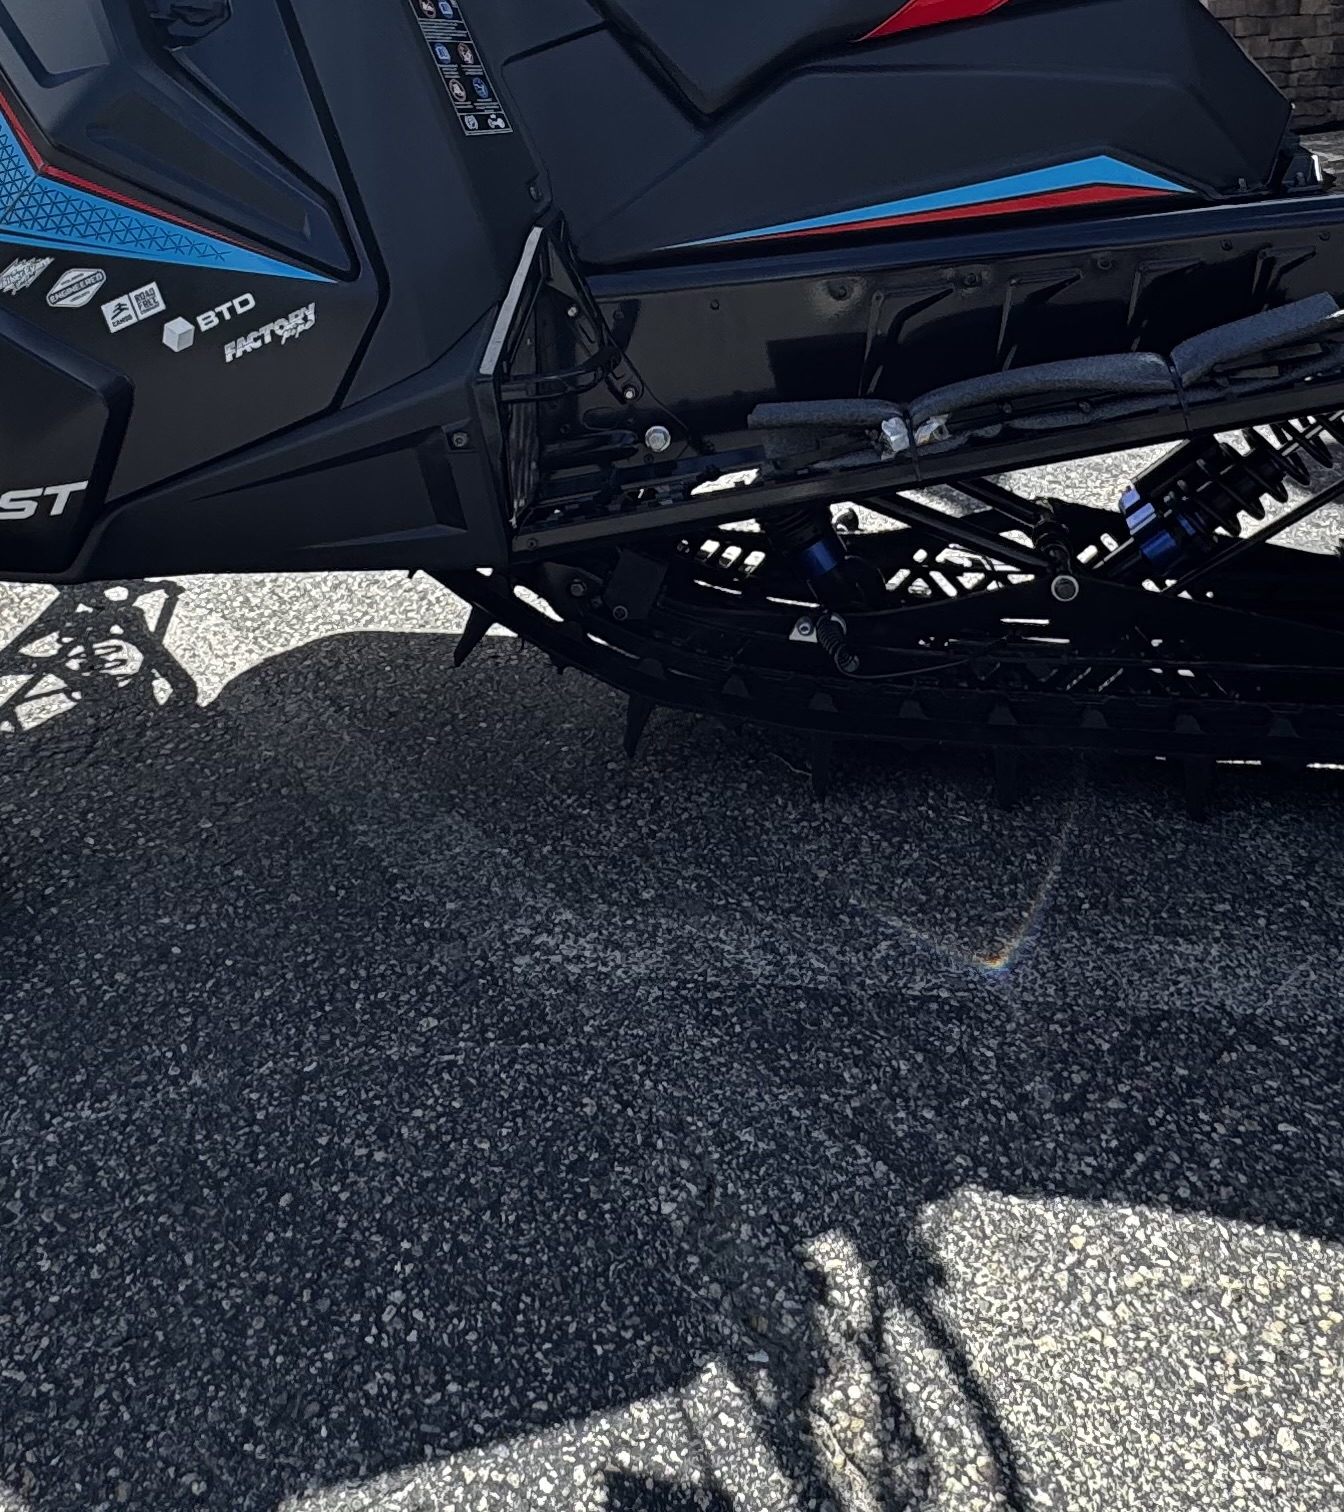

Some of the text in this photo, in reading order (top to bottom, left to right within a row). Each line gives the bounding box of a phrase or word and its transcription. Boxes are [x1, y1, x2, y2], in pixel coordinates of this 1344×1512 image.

[49, 272, 103, 304] ENGINEERED
[196, 292, 256, 332] BTD
[224, 302, 315, 363] FACTORY
